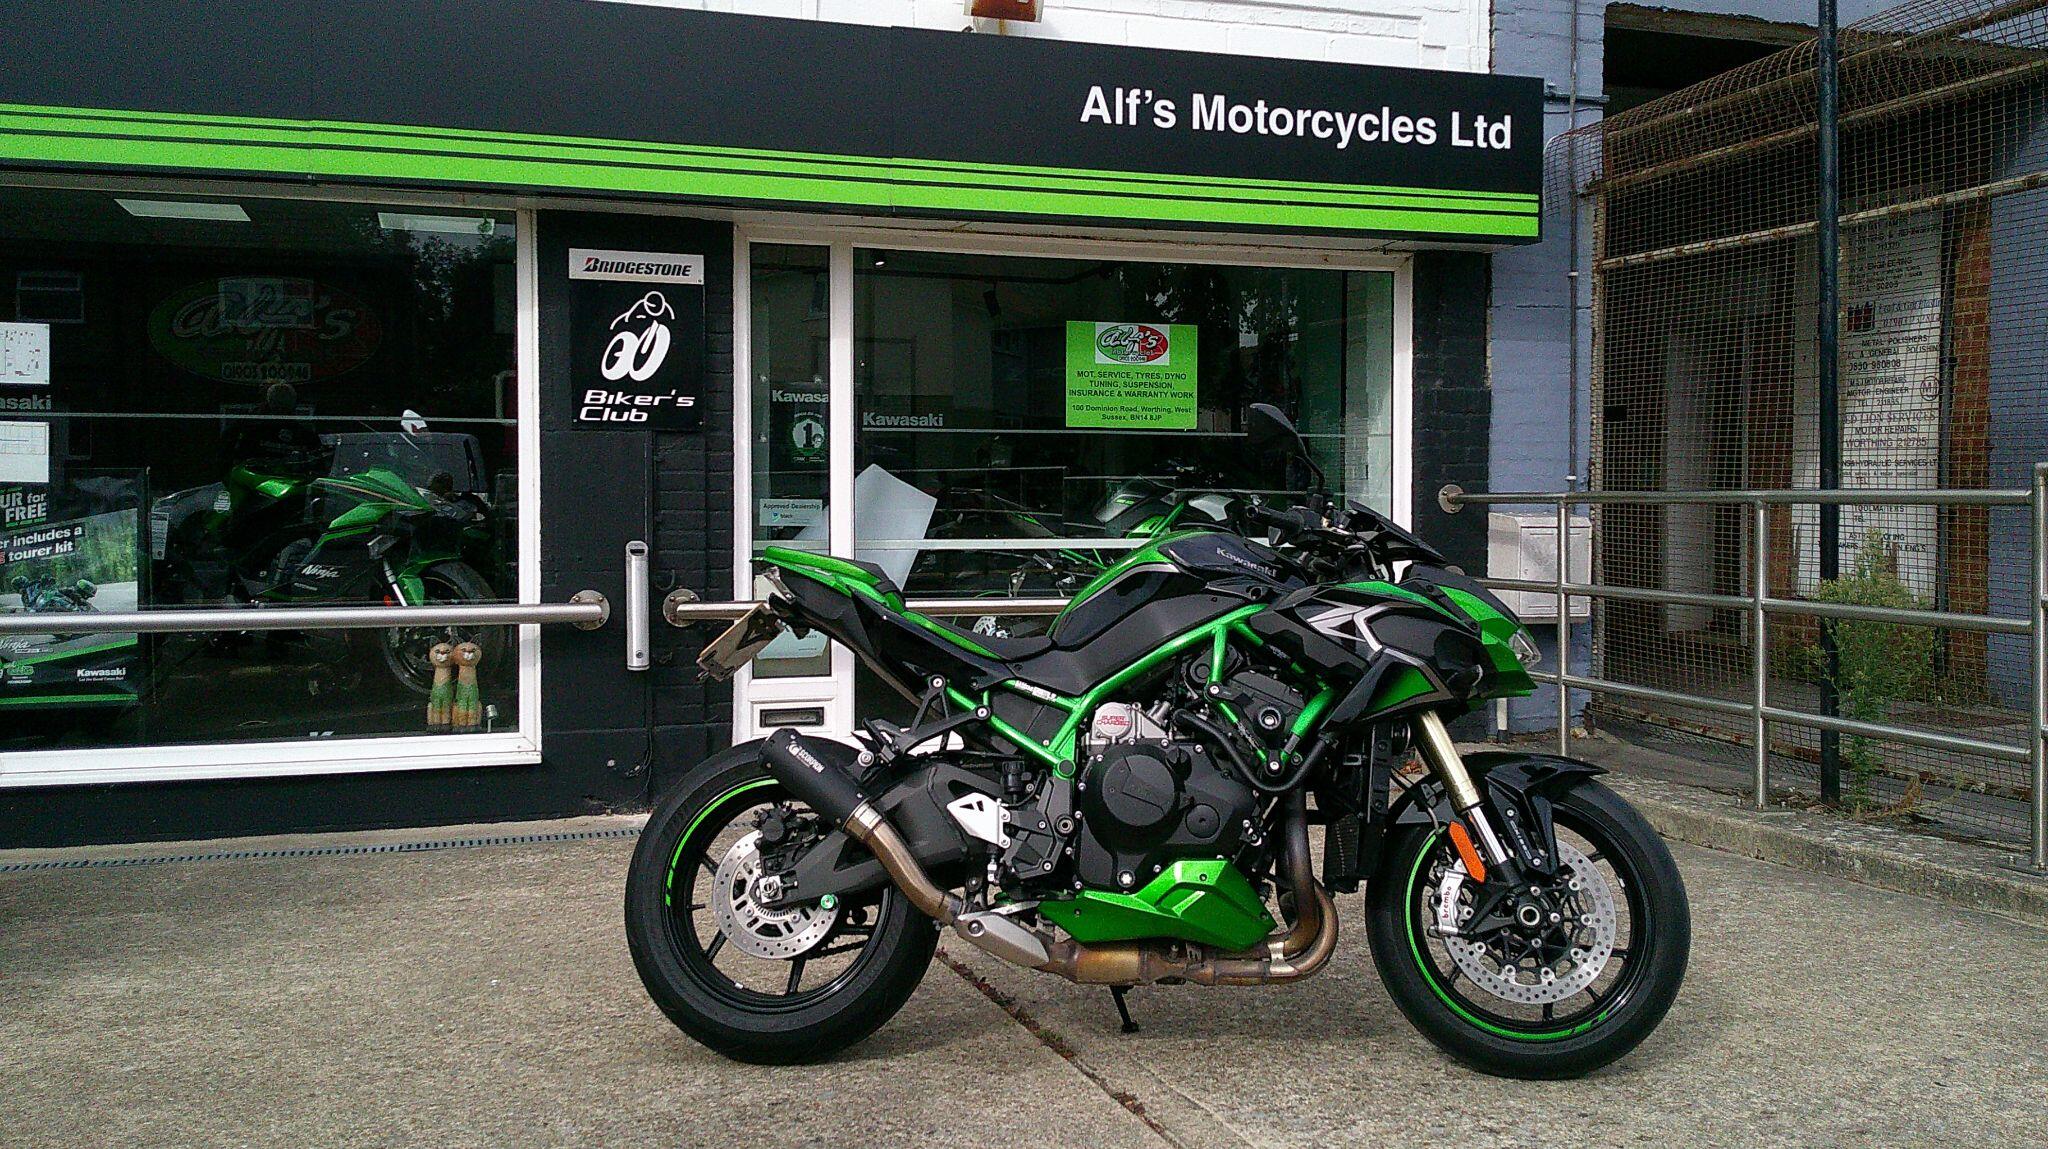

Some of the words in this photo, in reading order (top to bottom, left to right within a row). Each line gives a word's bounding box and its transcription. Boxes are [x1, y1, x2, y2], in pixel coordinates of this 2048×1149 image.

[1080, 86, 1176, 129] Alf's
[1193, 93, 1437, 149] Motorcycles
[1451, 110, 1512, 149] Ltd
[582, 257, 692, 277] BRIDGESTONE
[583, 389, 695, 407] Biker's
[1125, 390, 1169, 398] WARRANTY
[1170, 391, 1194, 399] WORK
[579, 406, 649, 422] Club
[862, 411, 944, 427] Kawasaki
[1846, 437, 1894, 448] WORTHING
[27, 492, 47, 504] for
[5, 502, 47, 522] FREE
[13, 528, 71, 548] includes
[73, 526, 83, 536] a
[8, 545, 52, 562] tourer
[55, 540, 75, 554] kit
[1216, 547, 1277, 577] Kawasaki
[301, 564, 341, 579] Ninja
[77, 667, 126, 678] Kawasaki
[1442, 886, 1452, 919] brembo
